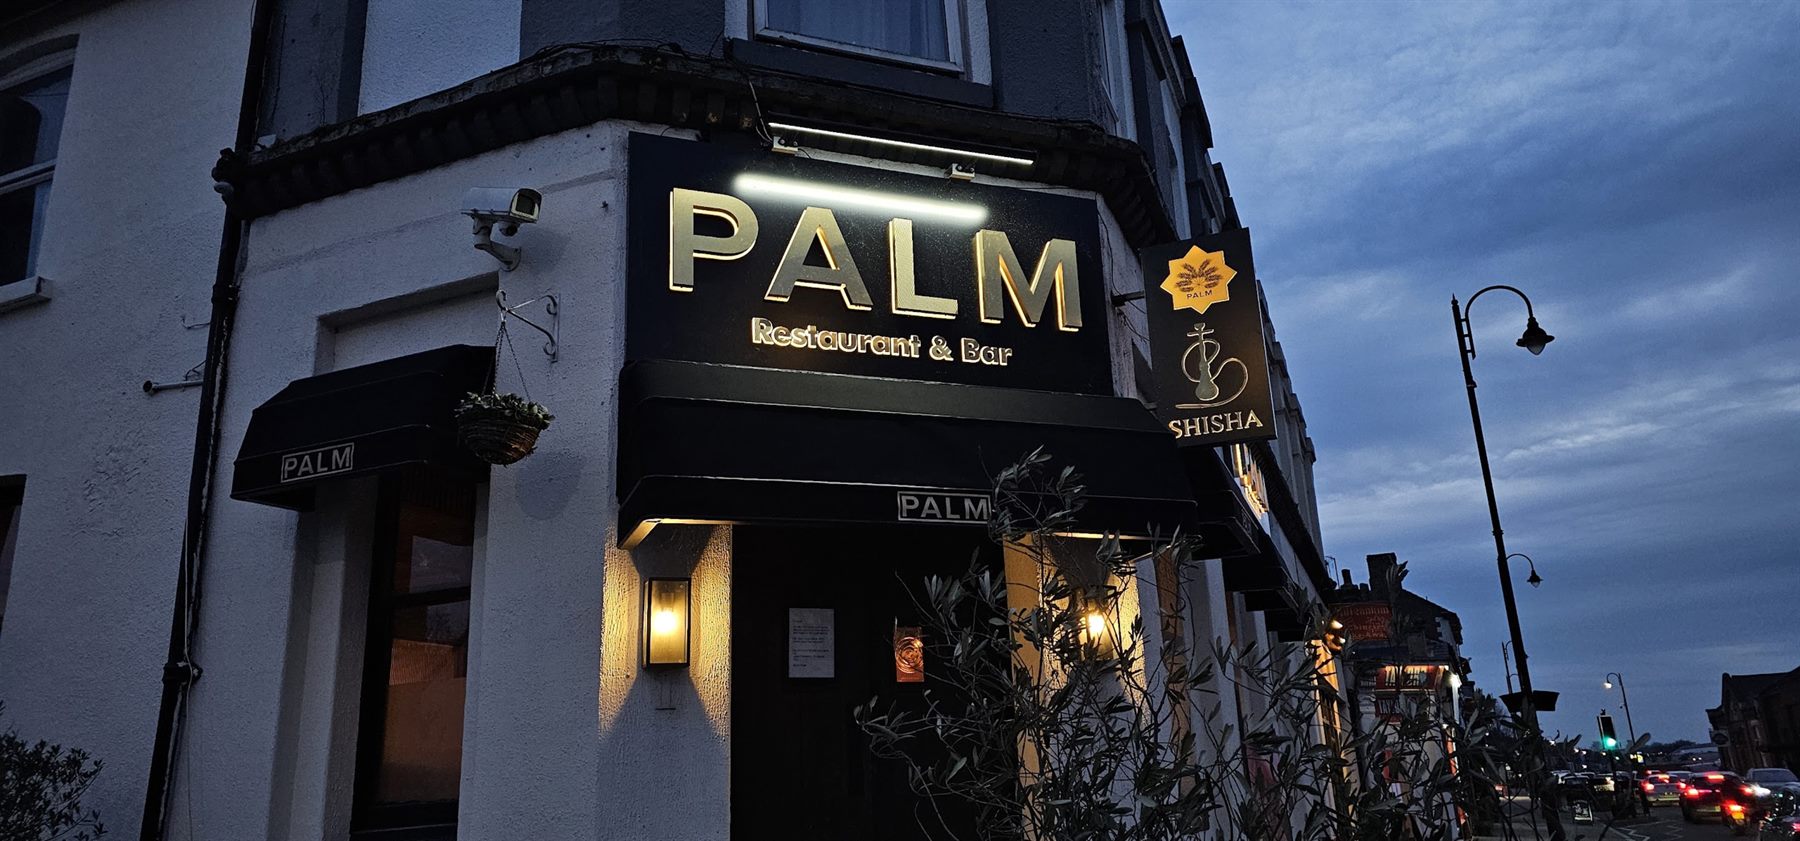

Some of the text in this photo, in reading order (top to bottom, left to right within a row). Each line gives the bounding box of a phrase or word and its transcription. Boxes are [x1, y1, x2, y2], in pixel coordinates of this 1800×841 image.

[669, 187, 1083, 332] PALM
[1186, 289, 1213, 300] PALM
[751, 317, 1013, 366] Restaurant & Bar
[1168, 409, 1264, 439] SHISHA
[284, 446, 351, 479] PALM
[901, 495, 989, 520] PALM
